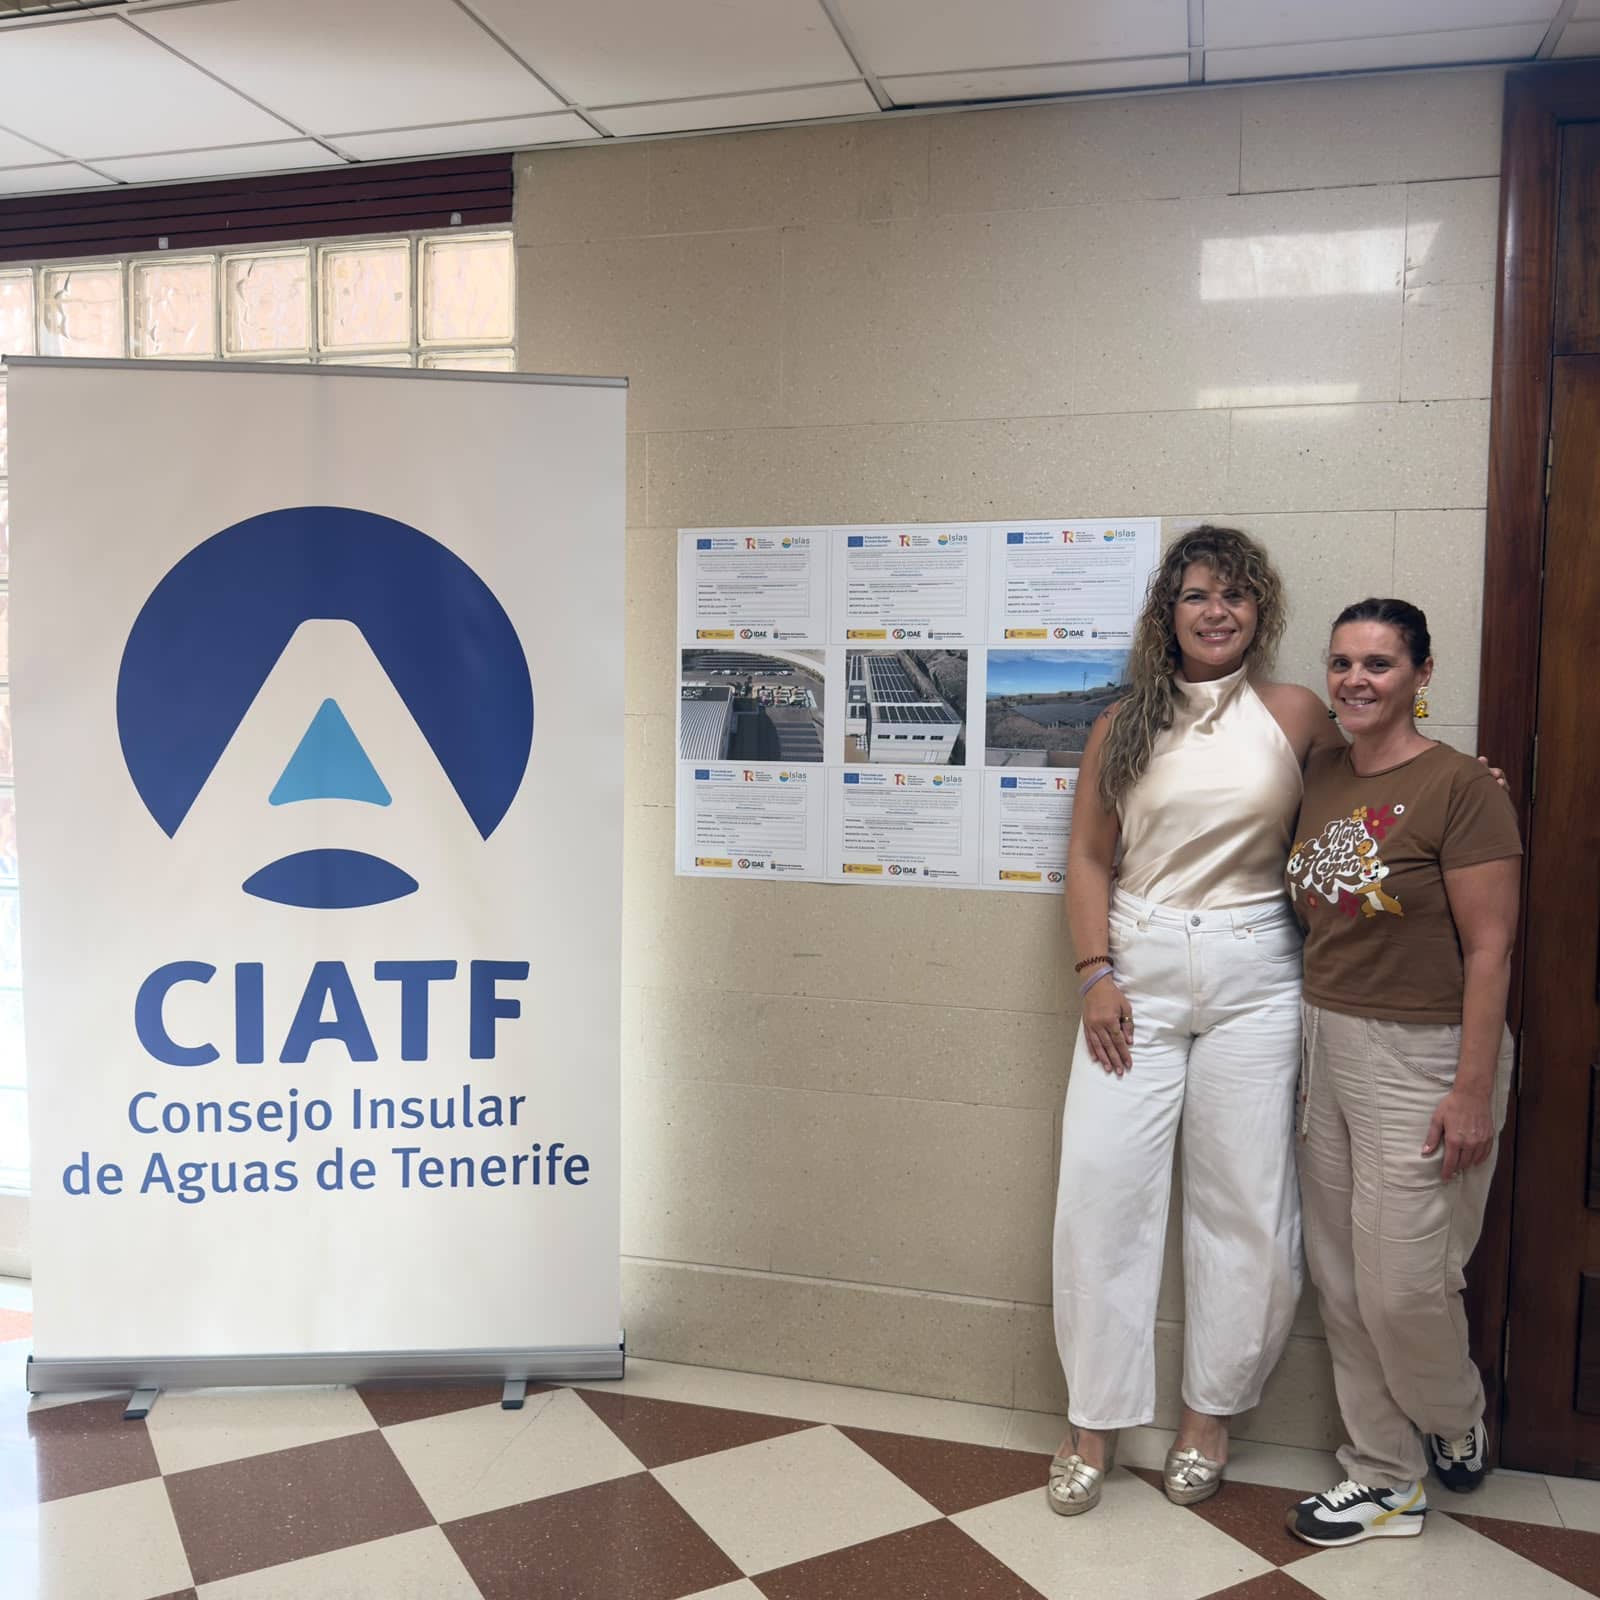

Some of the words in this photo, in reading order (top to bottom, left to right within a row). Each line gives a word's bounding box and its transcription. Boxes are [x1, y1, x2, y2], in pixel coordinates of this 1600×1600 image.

[792, 536, 810, 545] Islas
[948, 534, 967, 542] Islas
[1114, 529, 1136, 537] Islas
[789, 771, 807, 779] Islas
[1325, 819, 1365, 846] Make
[1303, 850, 1360, 878] Happen
[135, 960, 530, 1066] CIATF
[128, 1088, 332, 1142] Consejo
[353, 1085, 526, 1130] Insular
[62, 1151, 123, 1195] de
[140, 1152, 298, 1204] Aguas
[316, 1147, 376, 1191] de
[392, 1144, 589, 1188] Tenerife
